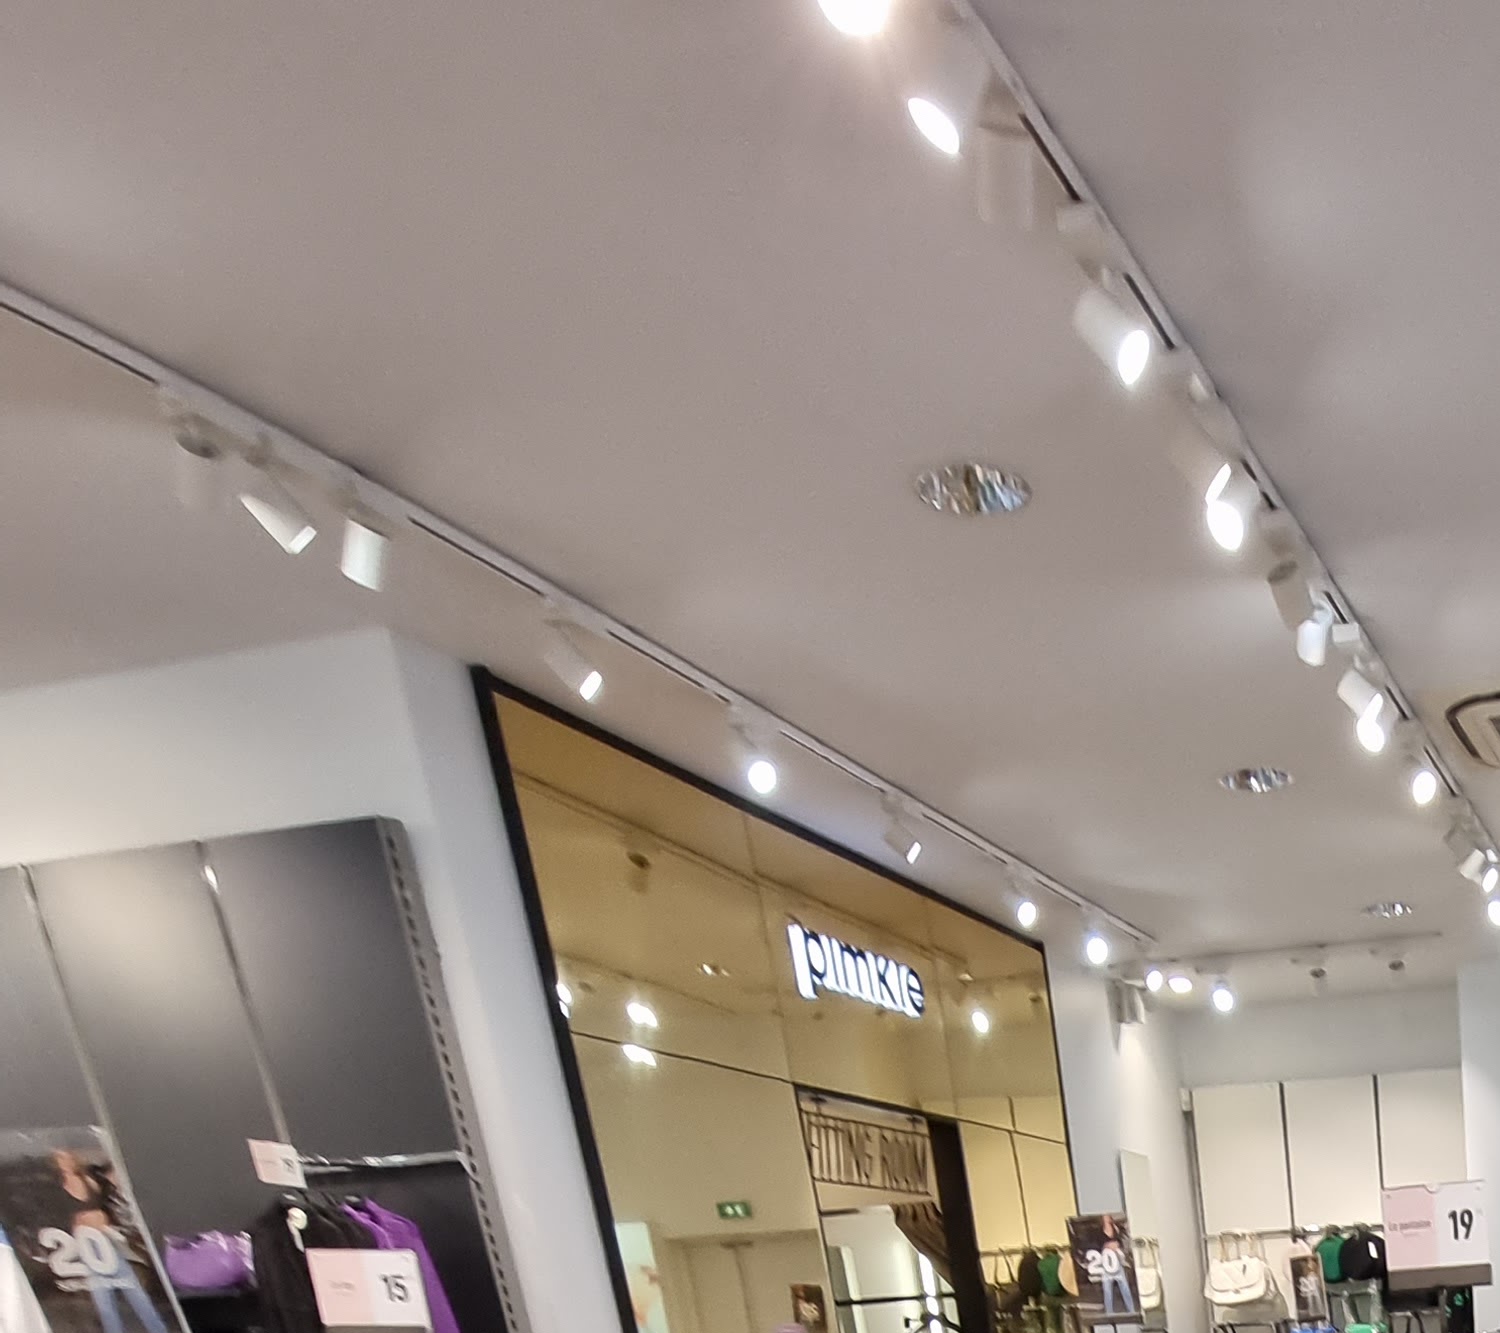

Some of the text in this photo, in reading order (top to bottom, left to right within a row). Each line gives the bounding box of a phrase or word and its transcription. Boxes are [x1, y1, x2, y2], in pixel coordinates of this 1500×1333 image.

[787, 923, 925, 1018] pimkie
[1448, 1209, 1473, 1240] 19
[379, 1273, 409, 1303] 15
